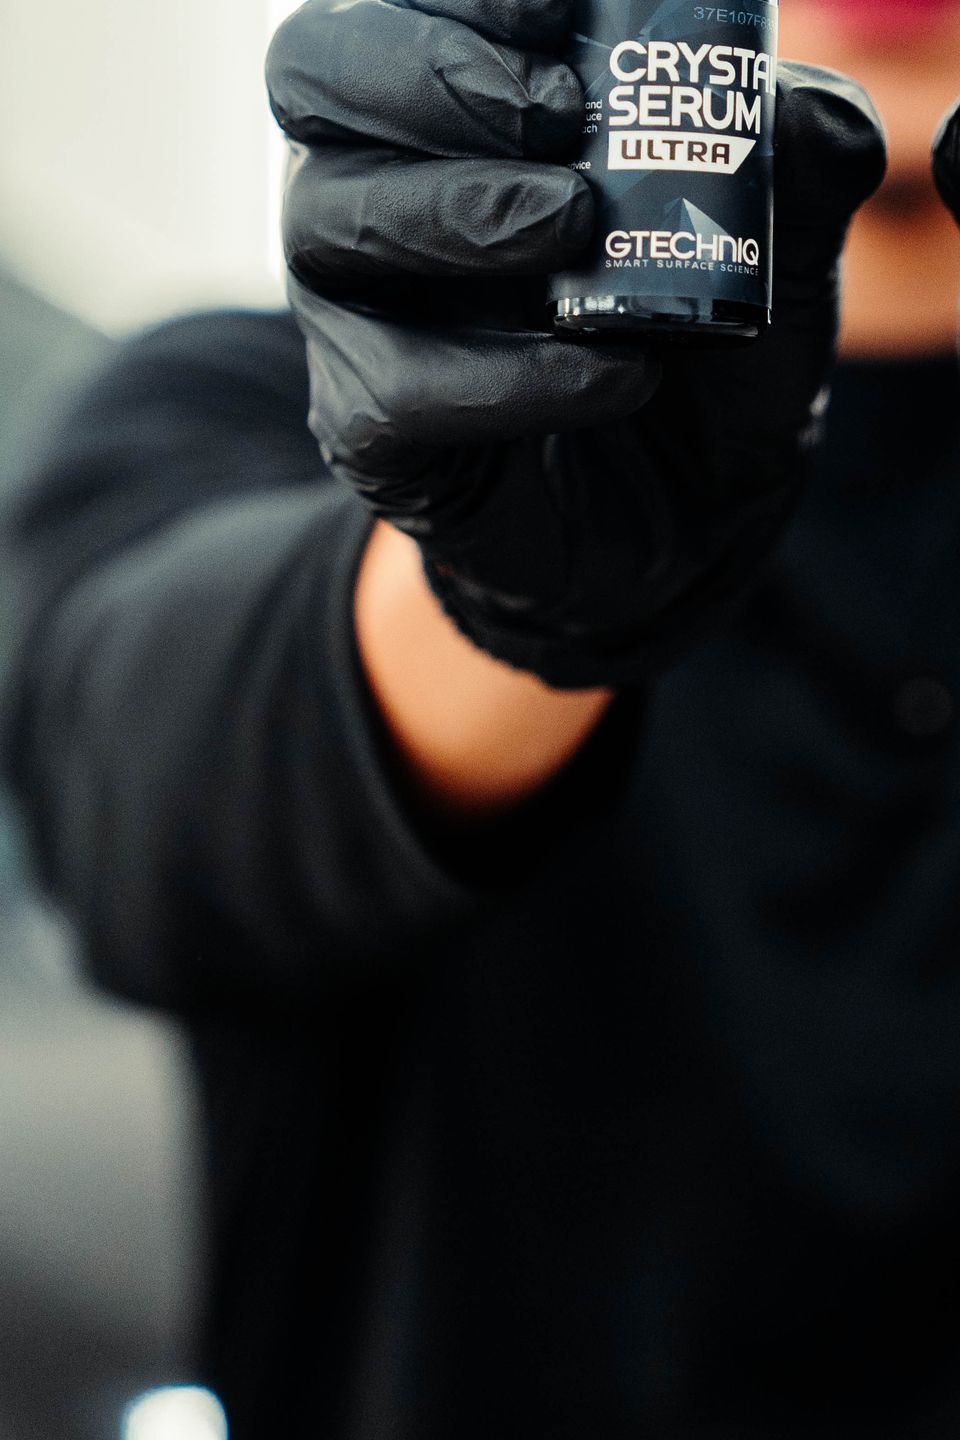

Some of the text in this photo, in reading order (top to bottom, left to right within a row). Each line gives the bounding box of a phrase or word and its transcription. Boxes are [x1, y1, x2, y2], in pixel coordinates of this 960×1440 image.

[609, 40, 776, 96] CRYSTAL
[586, 113, 602, 121] uce
[608, 85, 761, 134] SERUM
[621, 139, 730, 164] ULTRA
[605, 230, 759, 266] GTECHNIQ
[605, 259, 759, 276] SMART SURFACE SCIENCE
